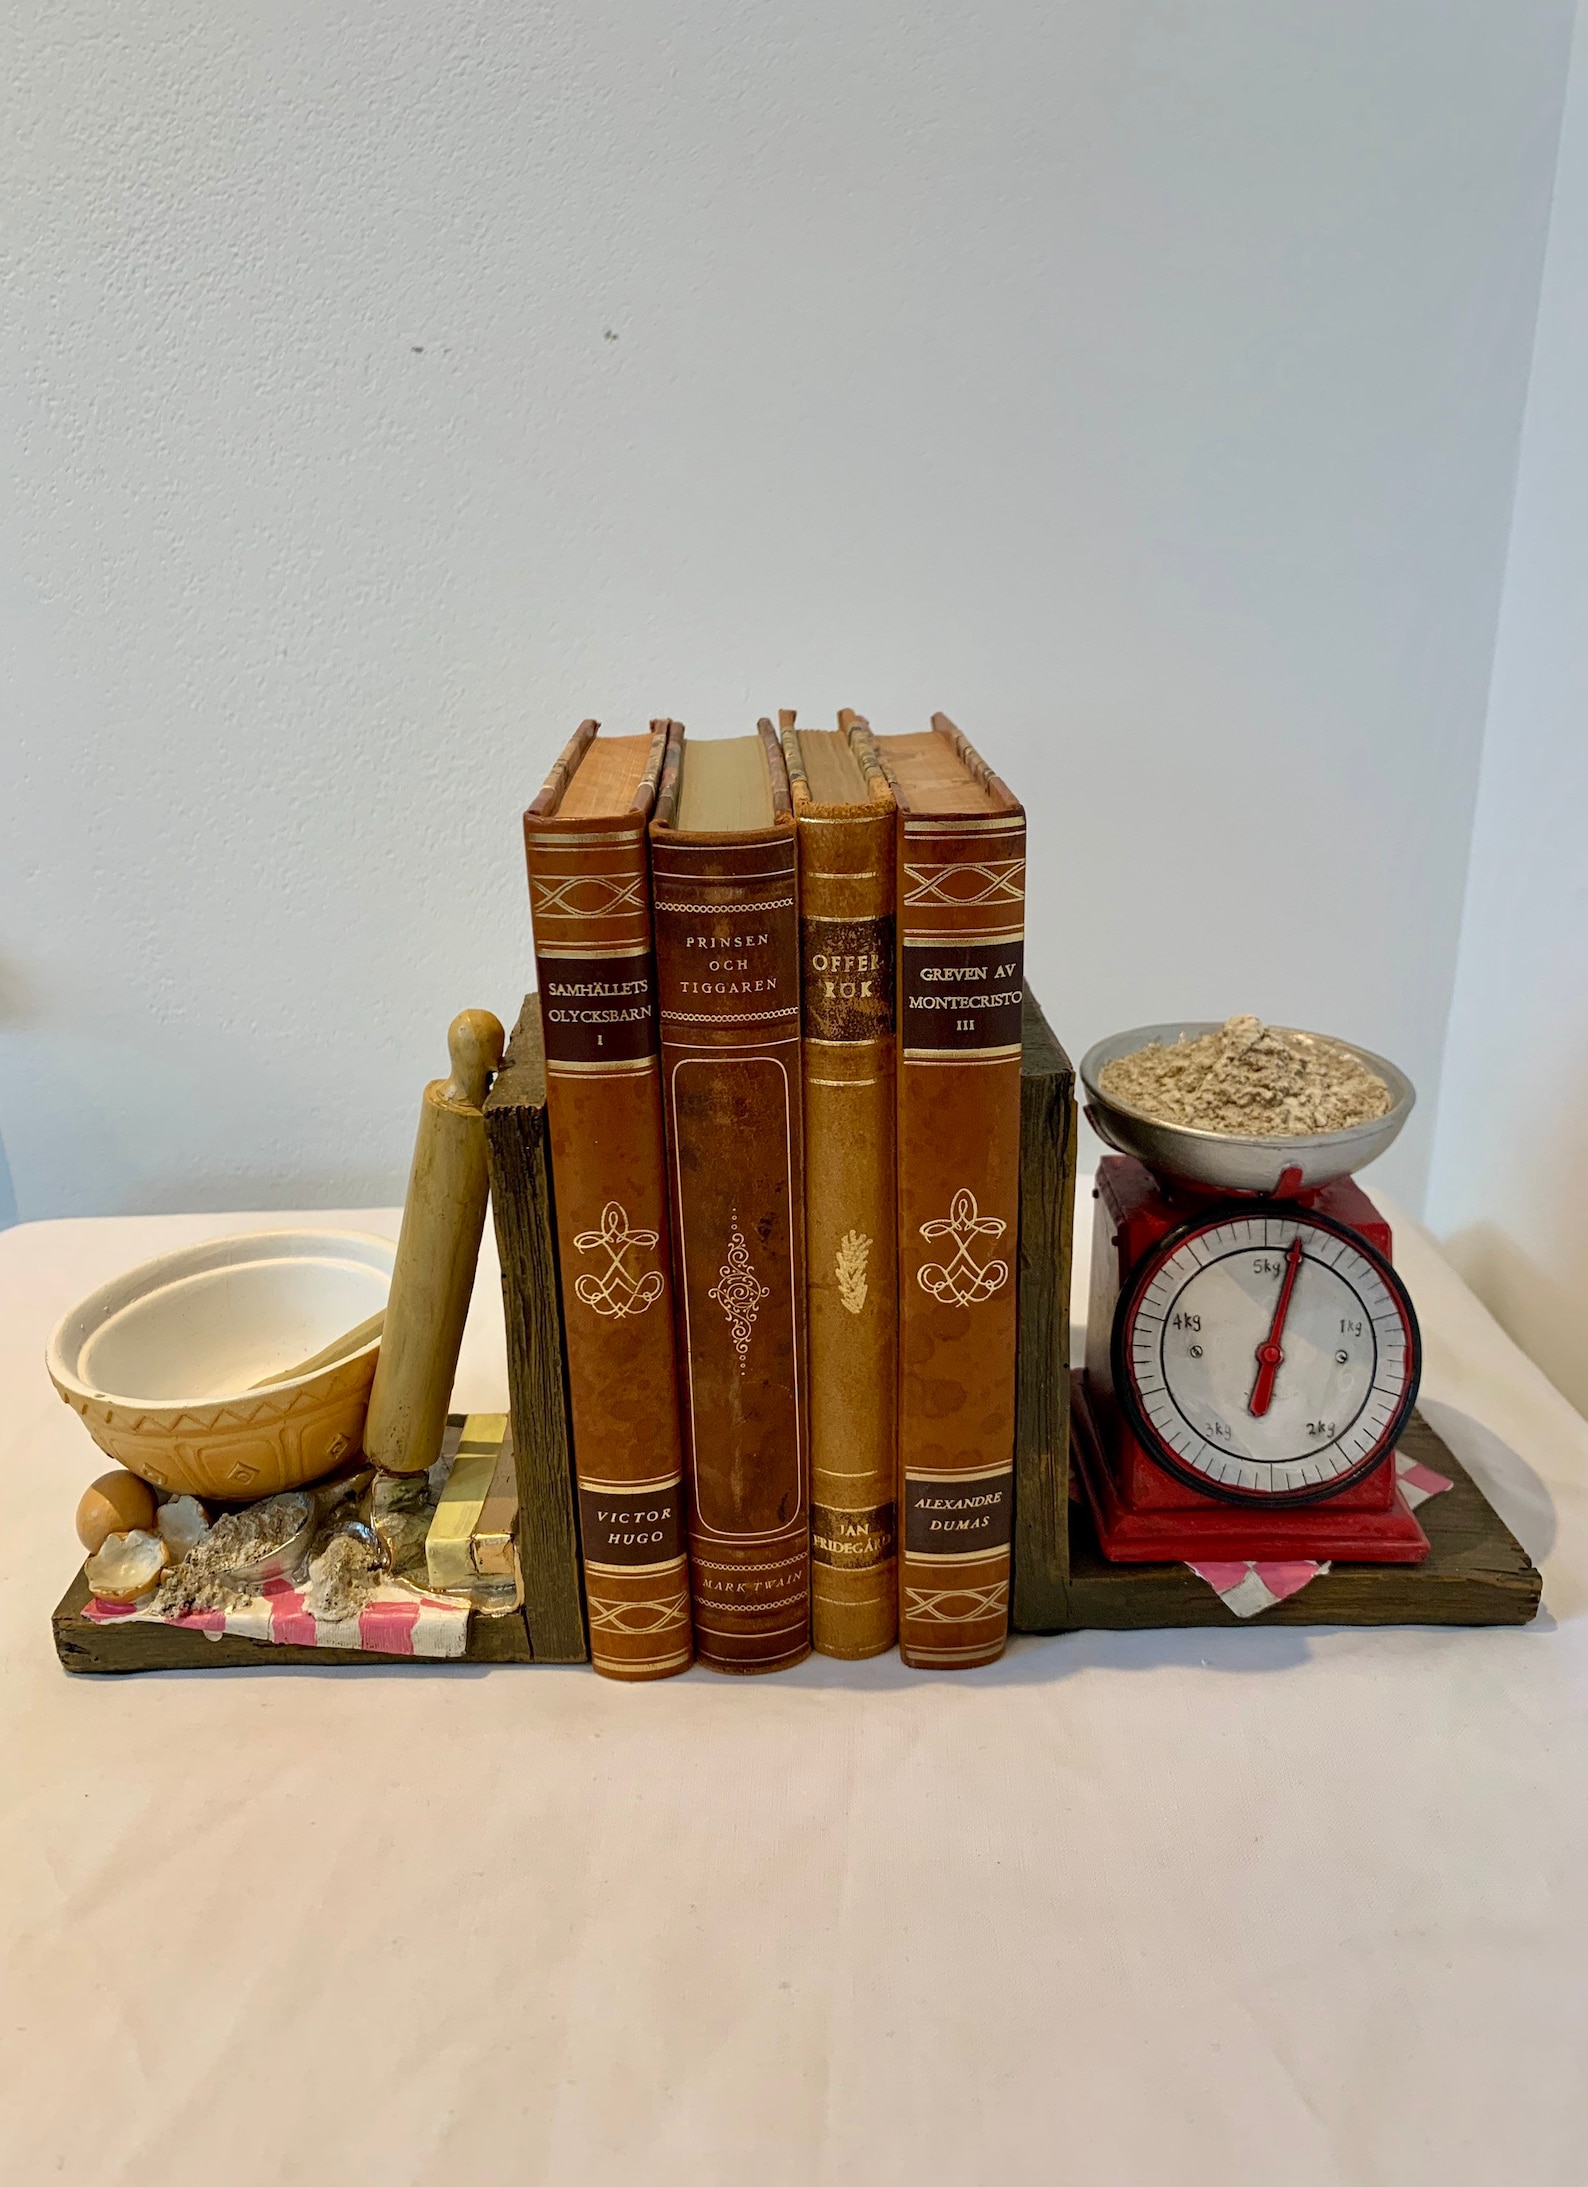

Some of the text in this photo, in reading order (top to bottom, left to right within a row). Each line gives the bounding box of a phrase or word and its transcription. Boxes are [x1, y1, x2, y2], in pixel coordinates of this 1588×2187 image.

[686, 933, 769, 949] PRINSEN
[709, 959, 748, 971] OCH
[812, 954, 880, 973] OFFER
[919, 963, 1017, 982] GREVEN AV
[548, 979, 648, 997] SAMHÄLLETS
[680, 978, 777, 994] TIGGAREN
[909, 990, 1023, 1010] MONTECRISTO
[548, 1005, 651, 1024] OLYCKSBARN
[956, 1020, 975, 1031] III
[597, 1034, 604, 1046] I
[1252, 1259, 1282, 1279] 5kg
[1172, 1312, 1202, 1331] 4kg
[1339, 1318, 1362, 1337] 1kg
[1205, 1420, 1232, 1440] 3kg
[1306, 1420, 1337, 1438] 2kg
[914, 1491, 1003, 1510] ALEXANDRE
[597, 1507, 673, 1524] VICTOR
[929, 1515, 990, 1532] DUMAS
[607, 1530, 664, 1546] HUGO
[840, 1523, 870, 1536] JAN
[702, 1569, 803, 1593] MARK TWAIN
